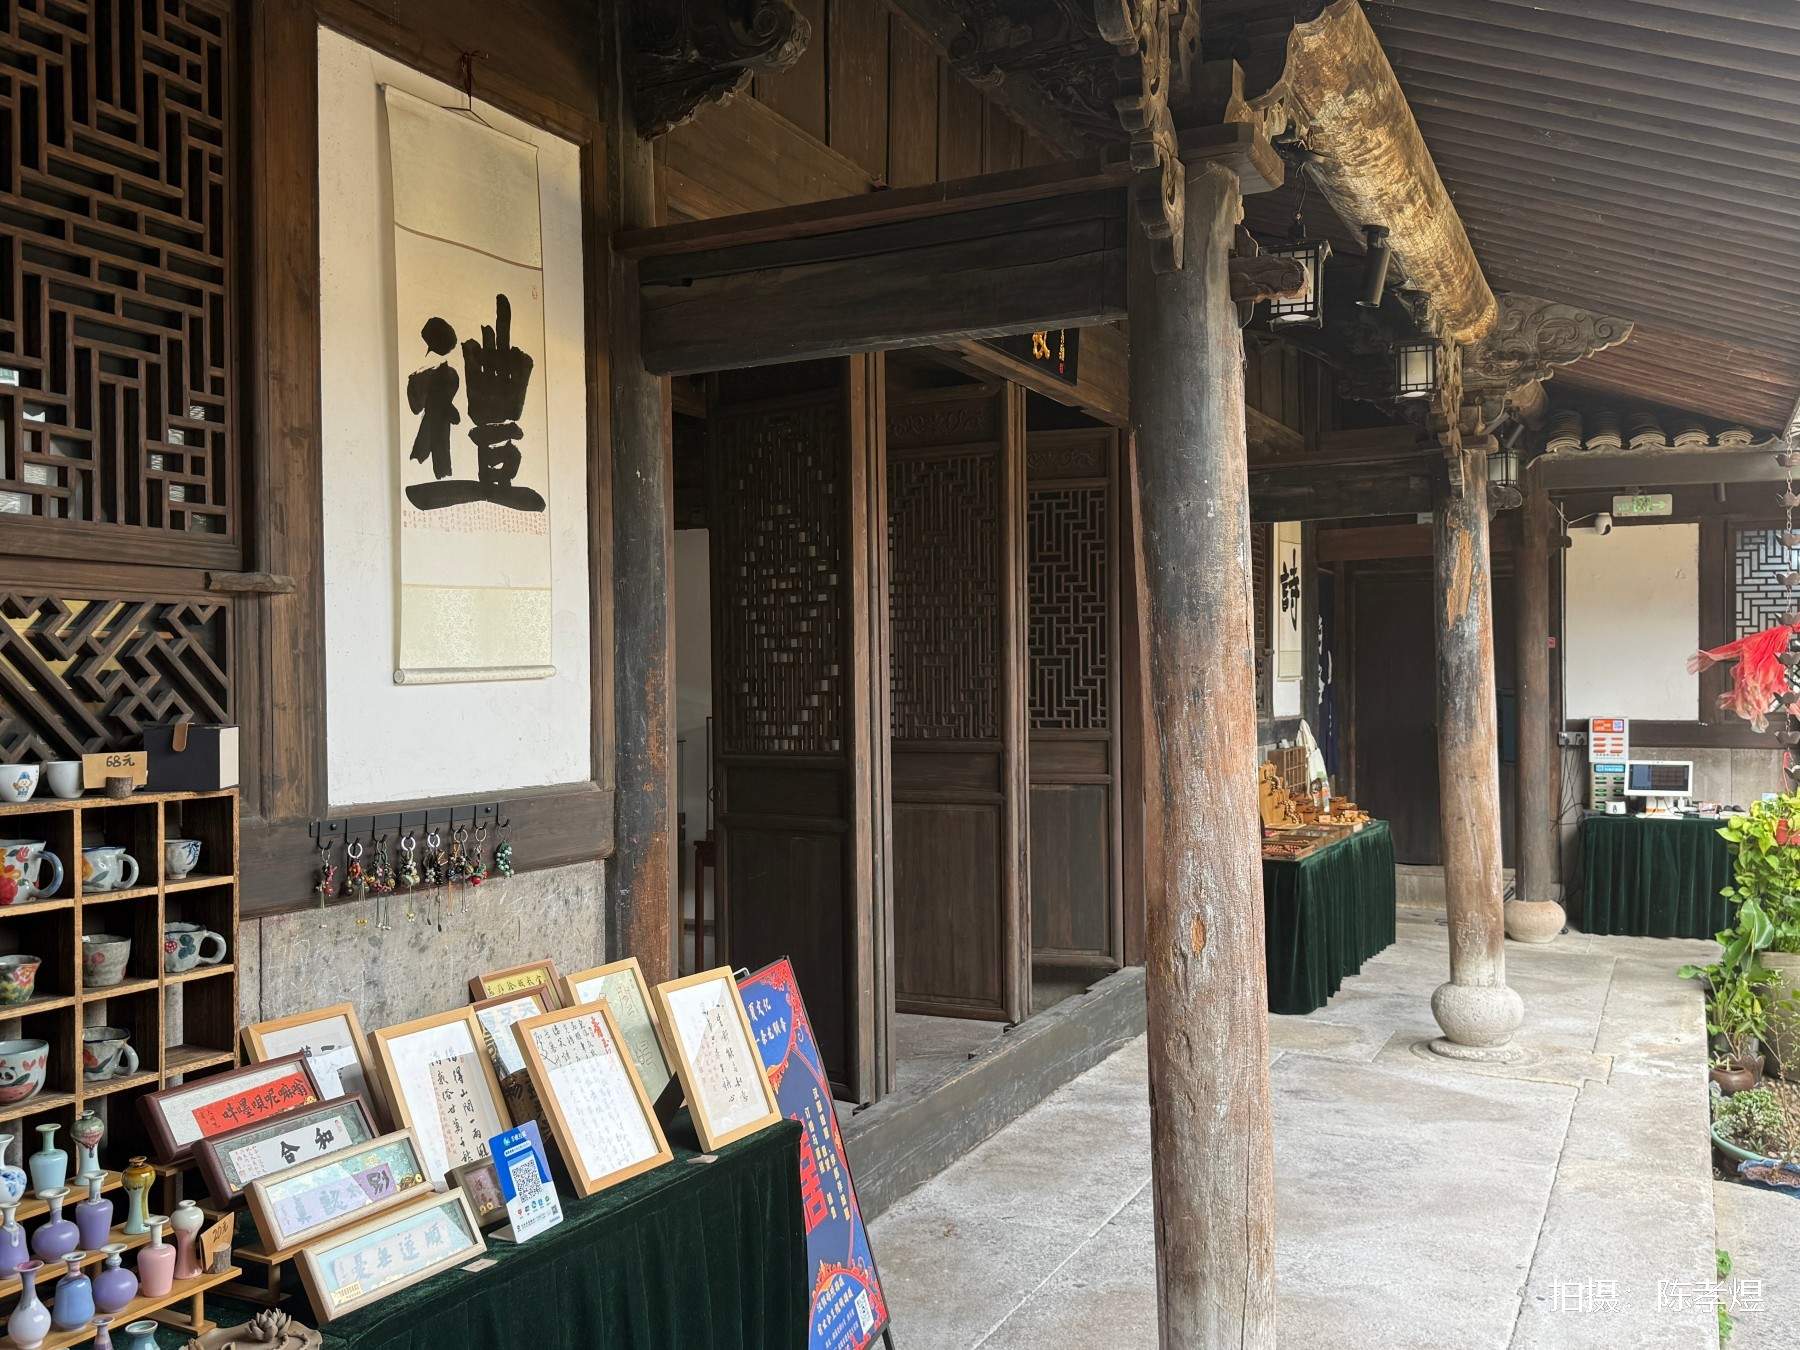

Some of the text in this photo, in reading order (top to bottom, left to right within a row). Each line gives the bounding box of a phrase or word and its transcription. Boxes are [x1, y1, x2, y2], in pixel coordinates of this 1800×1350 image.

[405, 293, 546, 513] 禮
[1280, 547, 1301, 632] 詩
[106, 754, 136, 768] 68元
